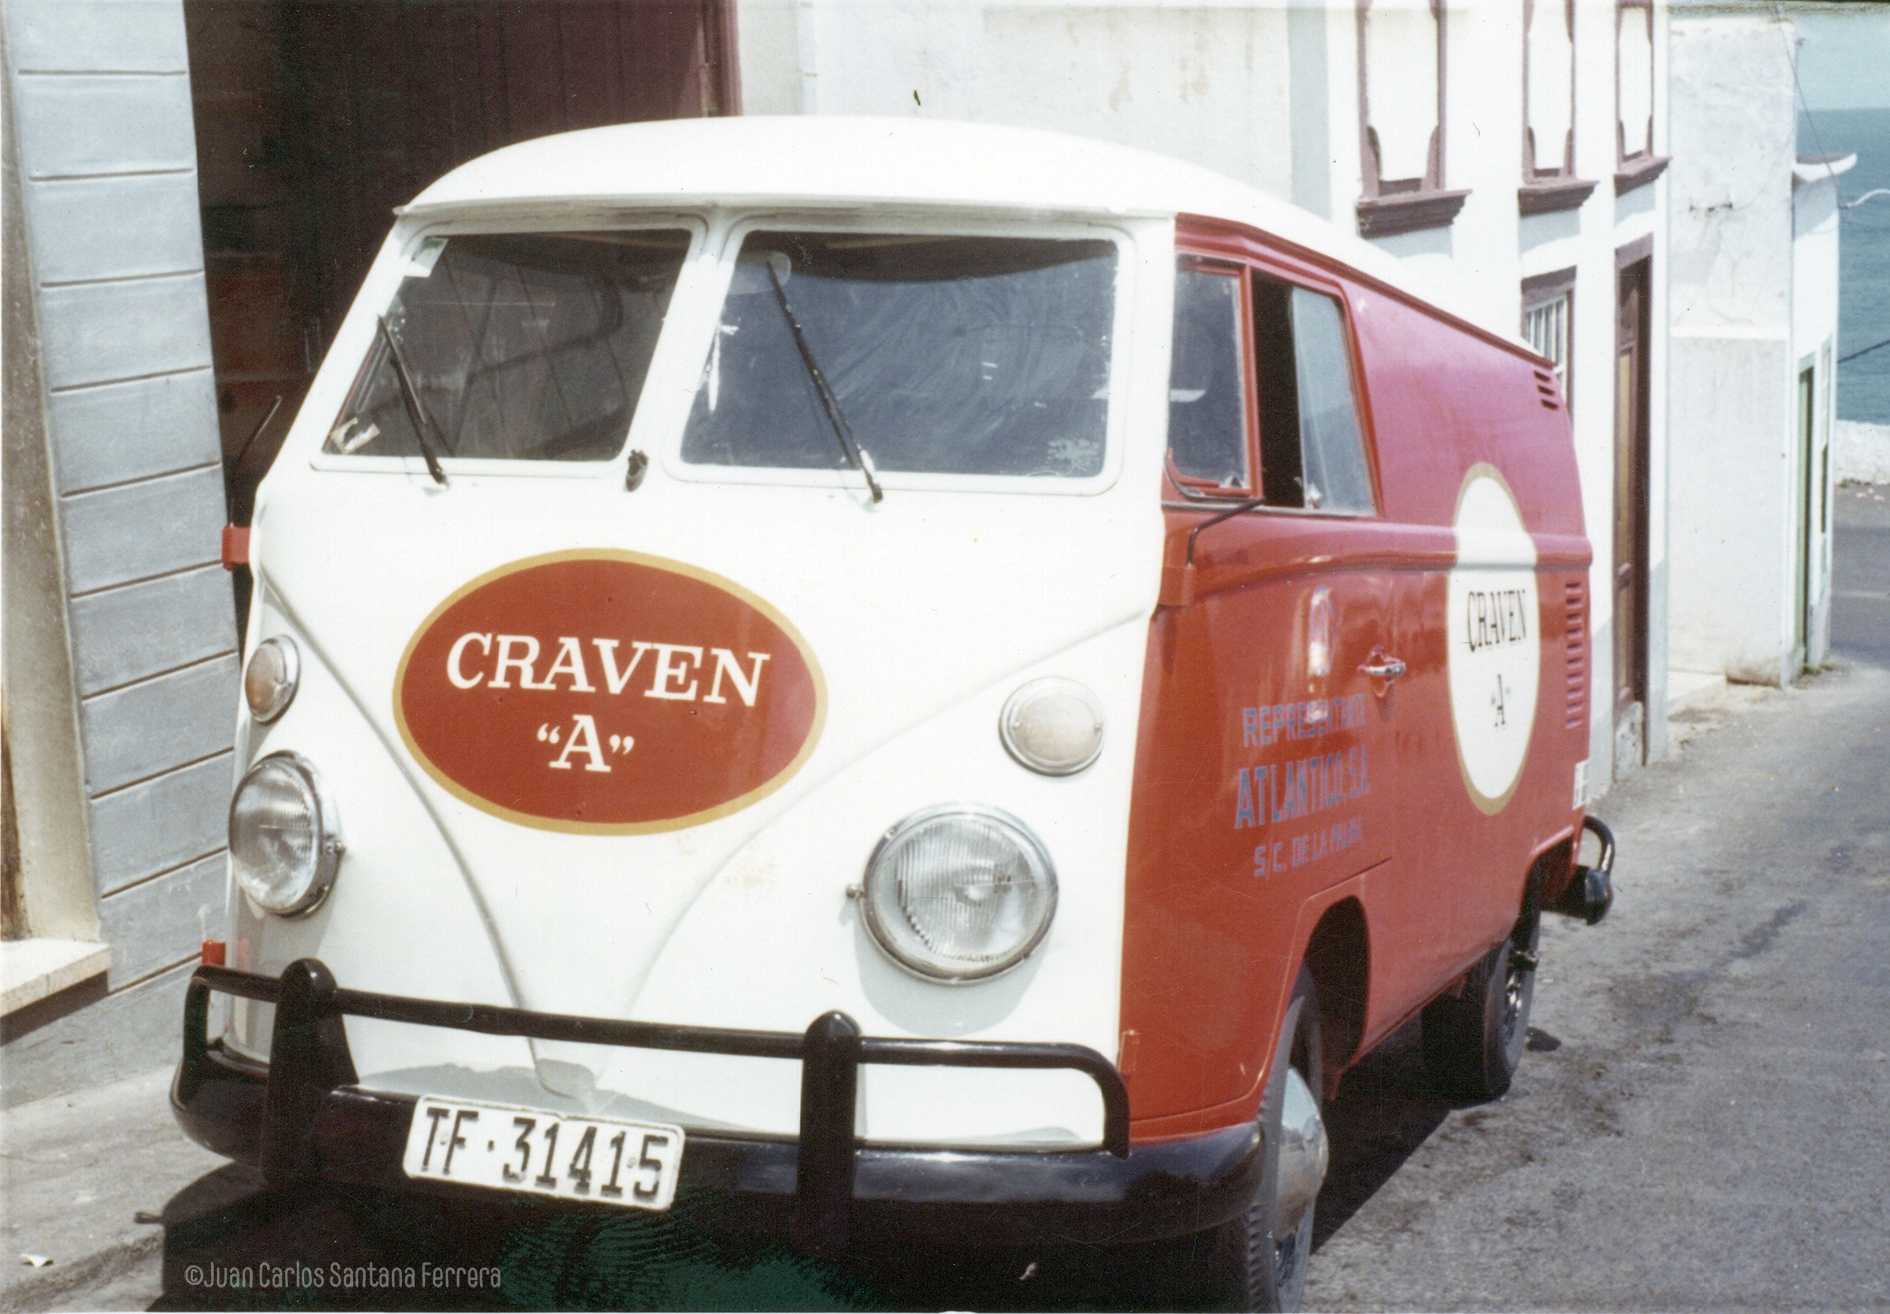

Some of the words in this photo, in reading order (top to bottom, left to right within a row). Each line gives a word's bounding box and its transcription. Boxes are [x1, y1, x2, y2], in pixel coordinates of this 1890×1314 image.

[1467, 589, 1526, 653] CRAVEN
[446, 632, 771, 707] CRAVEN
[536, 714, 635, 773] “A”
[1292, 834, 1310, 868] DE
